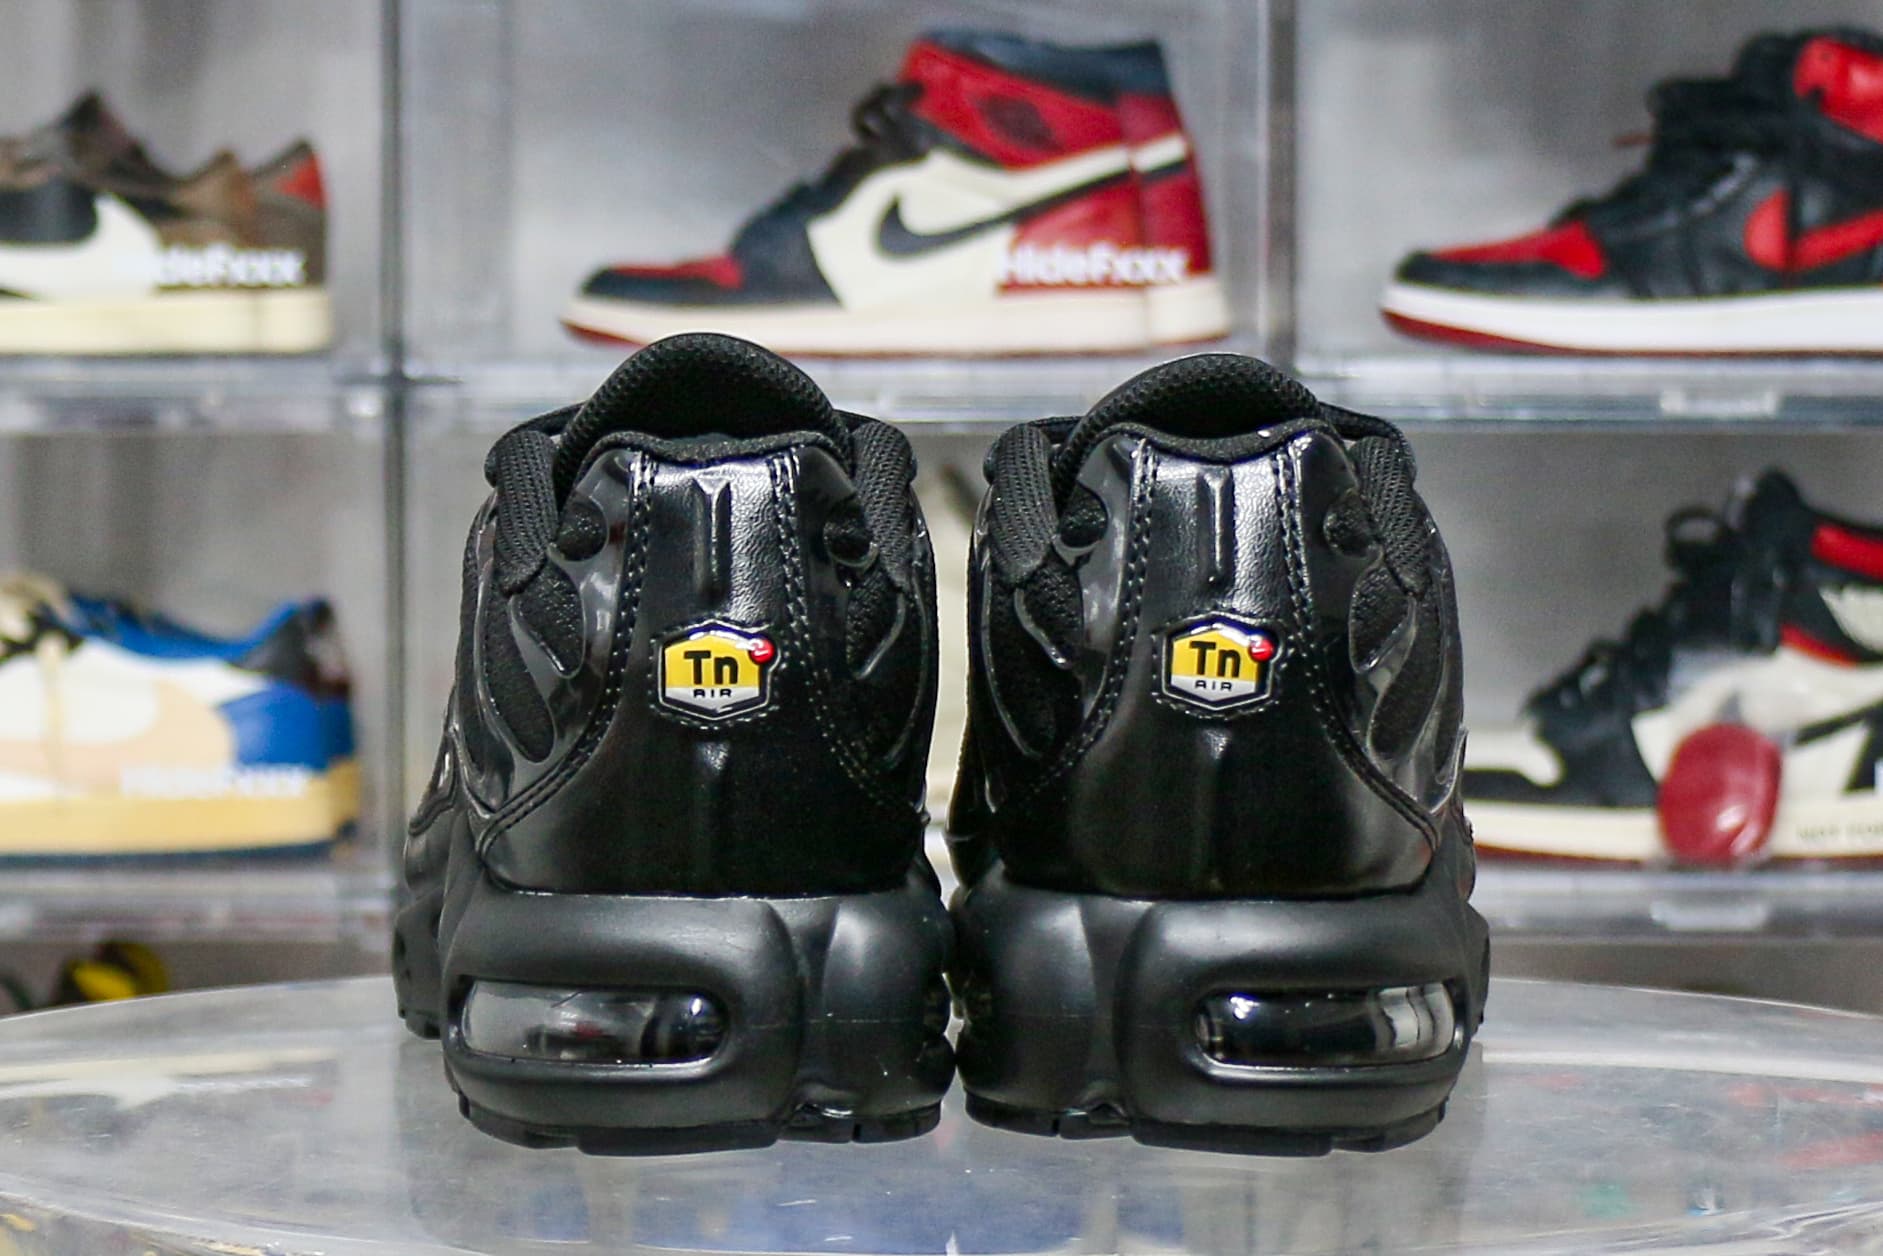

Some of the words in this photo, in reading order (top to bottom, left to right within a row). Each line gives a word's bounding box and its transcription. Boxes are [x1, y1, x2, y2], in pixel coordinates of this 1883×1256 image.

[683, 650, 738, 685] Tn
[1189, 641, 1241, 678] Tn
[693, 688, 732, 698] AIR
[1195, 680, 1232, 691] AIR
